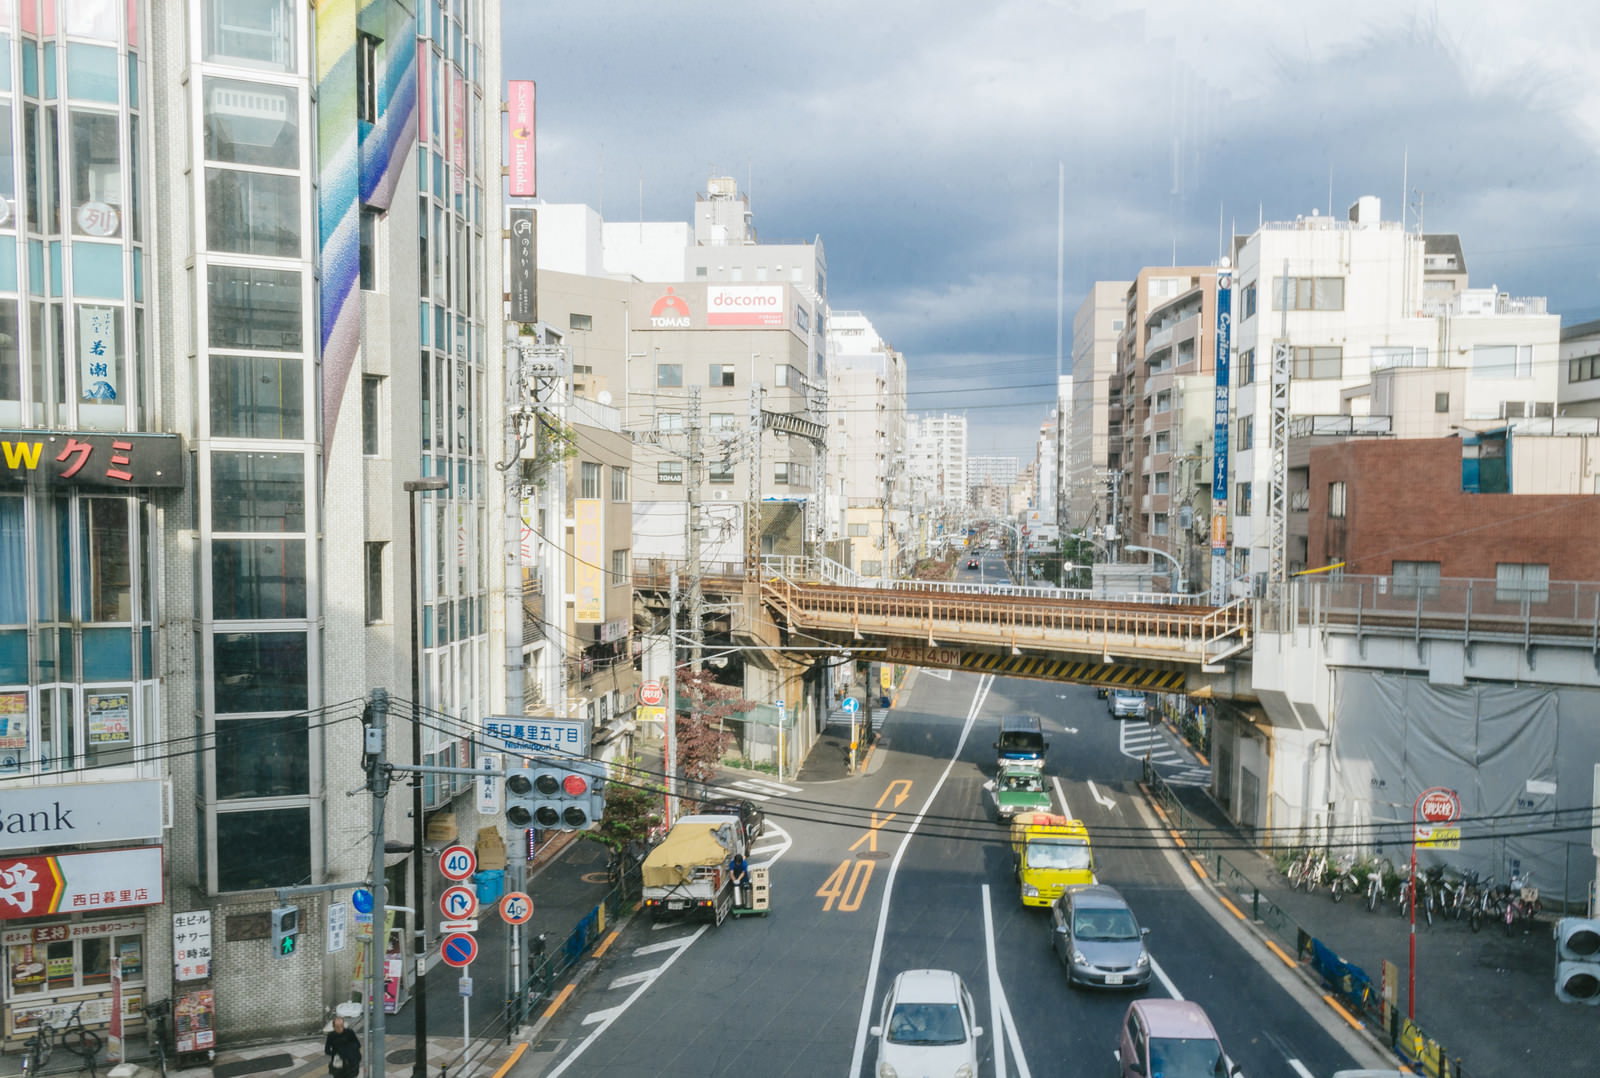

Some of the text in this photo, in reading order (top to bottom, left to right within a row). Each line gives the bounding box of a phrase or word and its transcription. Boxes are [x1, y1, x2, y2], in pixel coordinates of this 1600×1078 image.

[713, 293, 777, 306] docomo
[650, 317, 691, 327] TOMAS
[487, 723, 578, 742] 西日暮里五丁目
[447, 856, 468, 871] 40
[815, 859, 877, 912] 40
[72, 888, 149, 907] 西日暮里店
[175, 914, 209, 927] 生ビール
[175, 932, 209, 943] サワー
